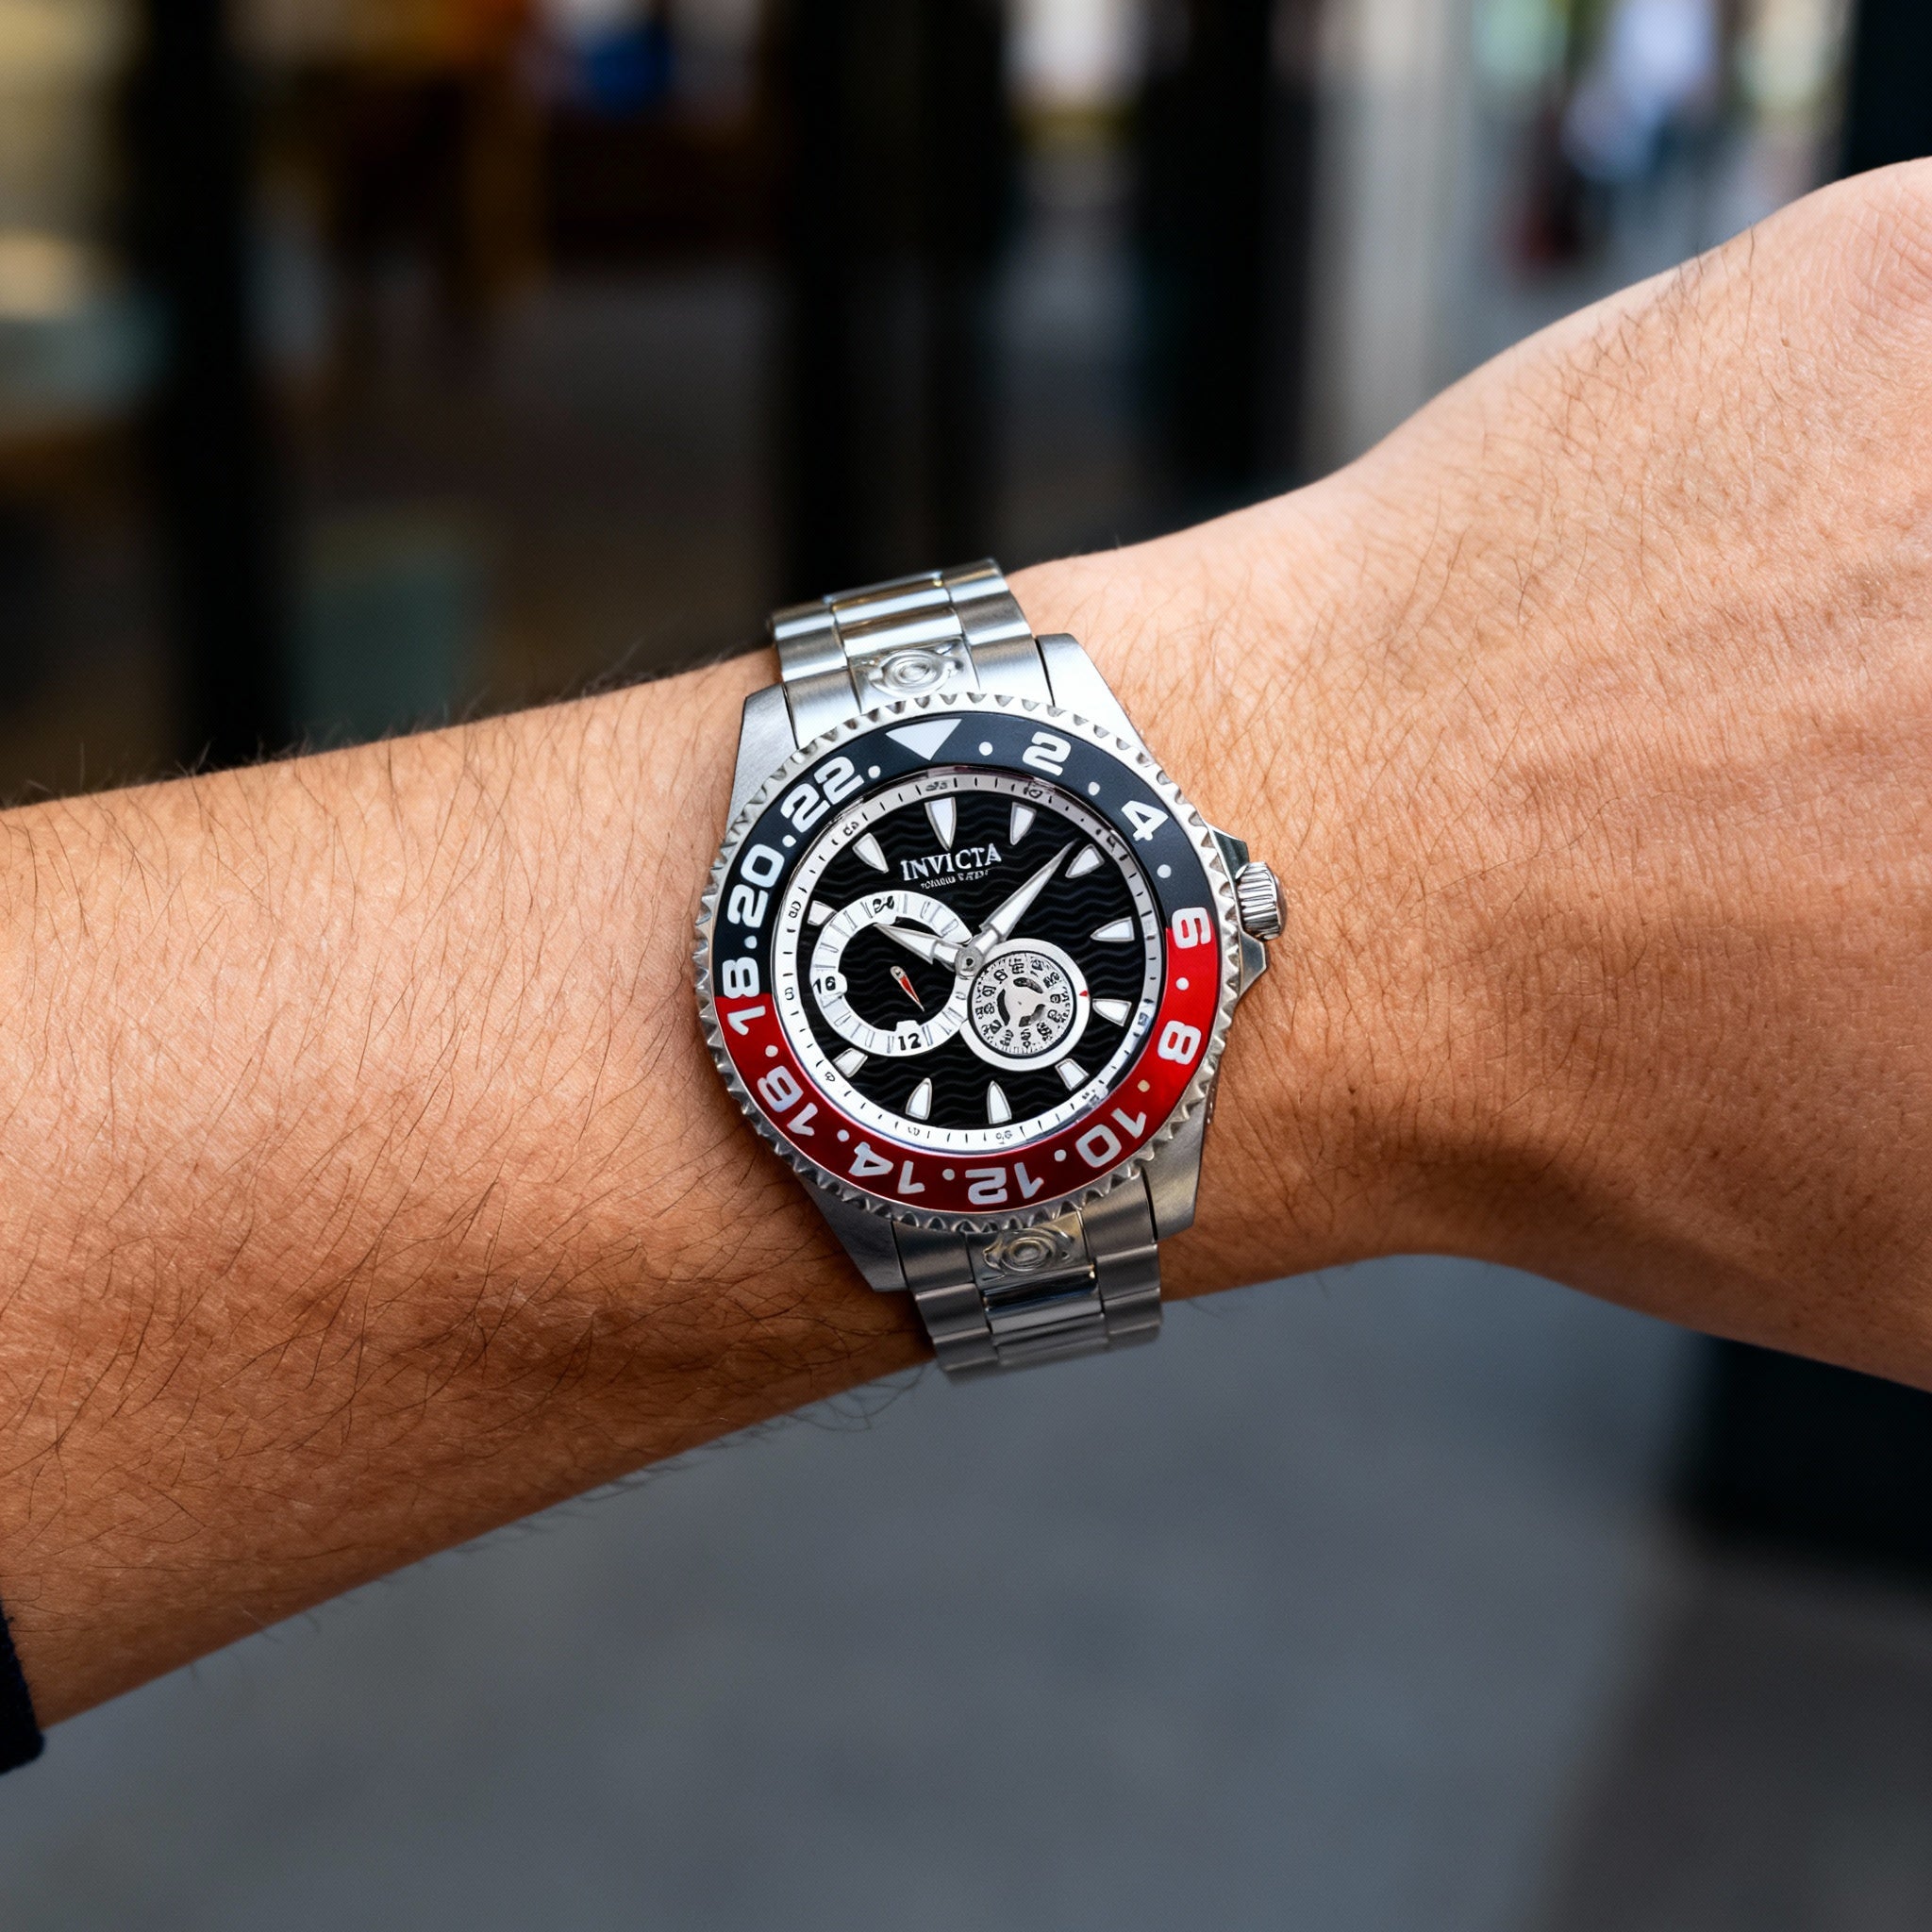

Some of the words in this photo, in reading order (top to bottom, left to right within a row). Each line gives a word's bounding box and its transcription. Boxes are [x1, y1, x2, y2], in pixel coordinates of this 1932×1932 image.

[1023, 731, 1071, 775] 2
[780, 757, 865, 834] 22
[1121, 801, 1169, 841] 4
[900, 842, 1002, 881] INVICTA
[727, 843, 784, 928] 20
[1172, 908, 1211, 948] 6
[723, 957, 766, 1036] 18
[813, 975, 837, 994] 16
[898, 1032, 922, 1051] 12
[1158, 1021, 1202, 1064] 8
[758, 1066, 819, 1137] 16
[1075, 1108, 1147, 1168] 10
[849, 1142, 925, 1194] 14
[966, 1163, 1044, 1205] 12
